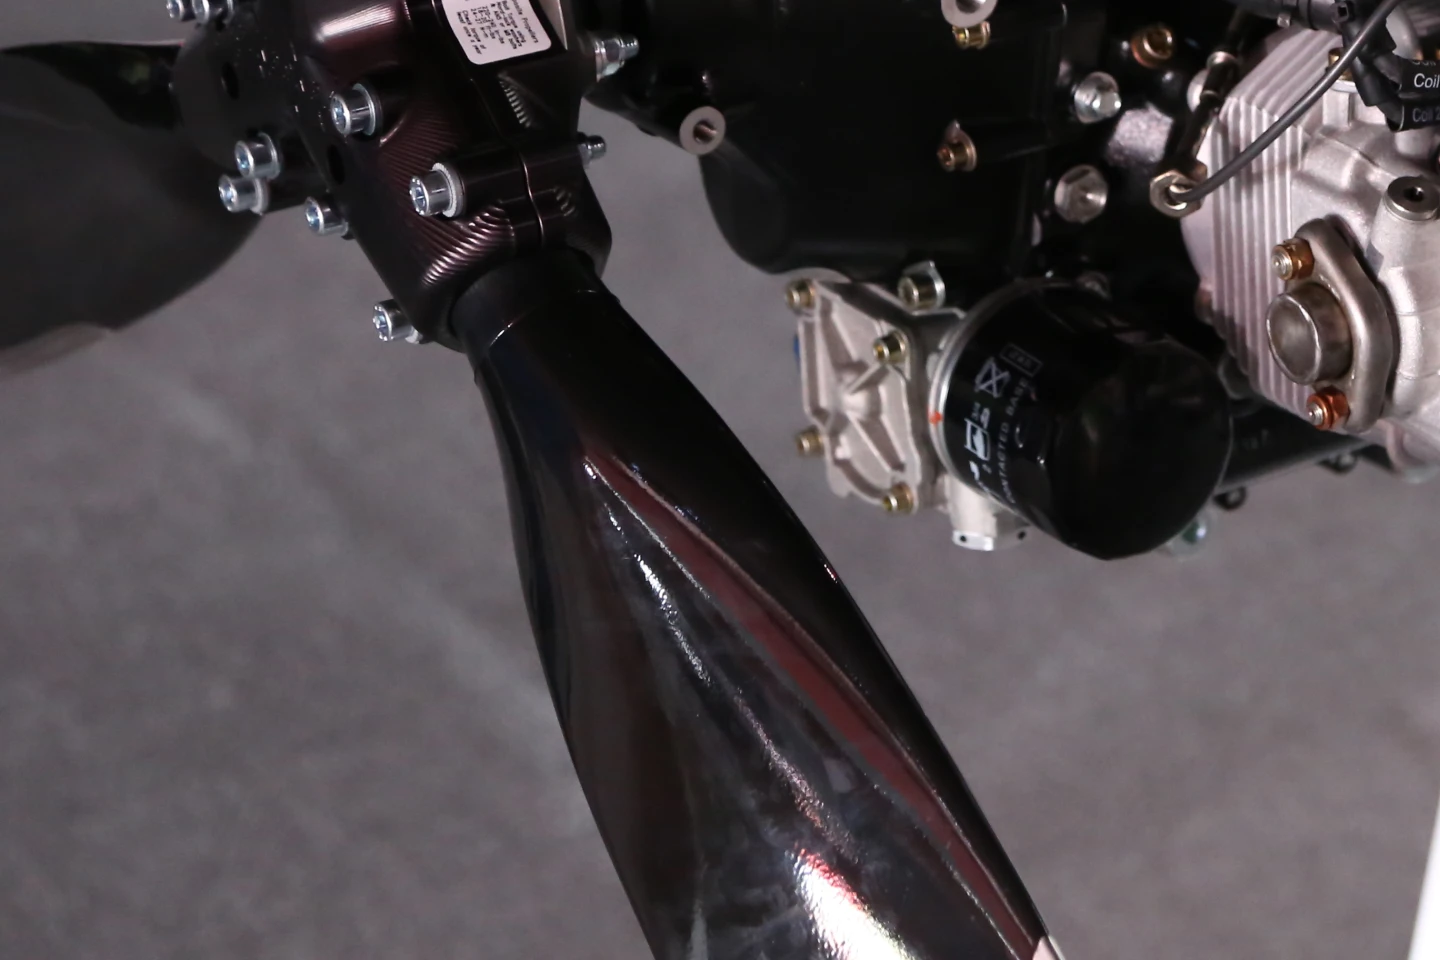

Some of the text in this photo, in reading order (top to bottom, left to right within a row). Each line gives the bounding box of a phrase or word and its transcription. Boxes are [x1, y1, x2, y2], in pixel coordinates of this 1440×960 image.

[522, 17, 539, 43] Propellers
[1413, 73, 1440, 88] Coil
[1412, 107, 1433, 122] Coil
